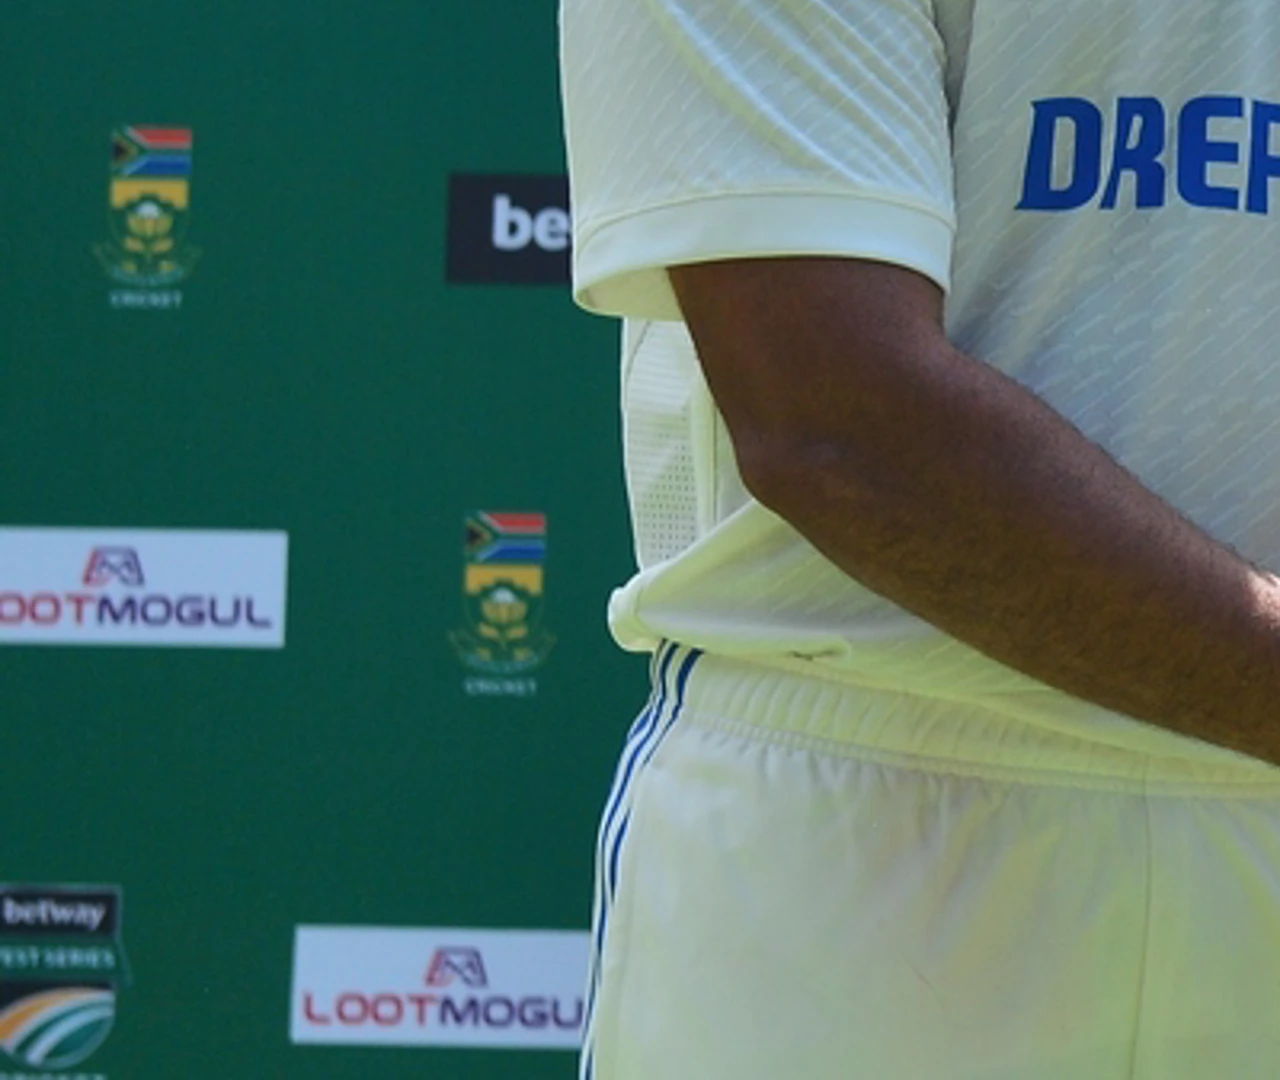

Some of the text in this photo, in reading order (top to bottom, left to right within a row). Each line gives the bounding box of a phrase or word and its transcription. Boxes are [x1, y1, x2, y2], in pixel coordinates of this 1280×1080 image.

[0, 592, 271, 629] OOTMOGUL
[3, 898, 106, 931] betway
[303, 992, 583, 1031] LOOTMOGU
